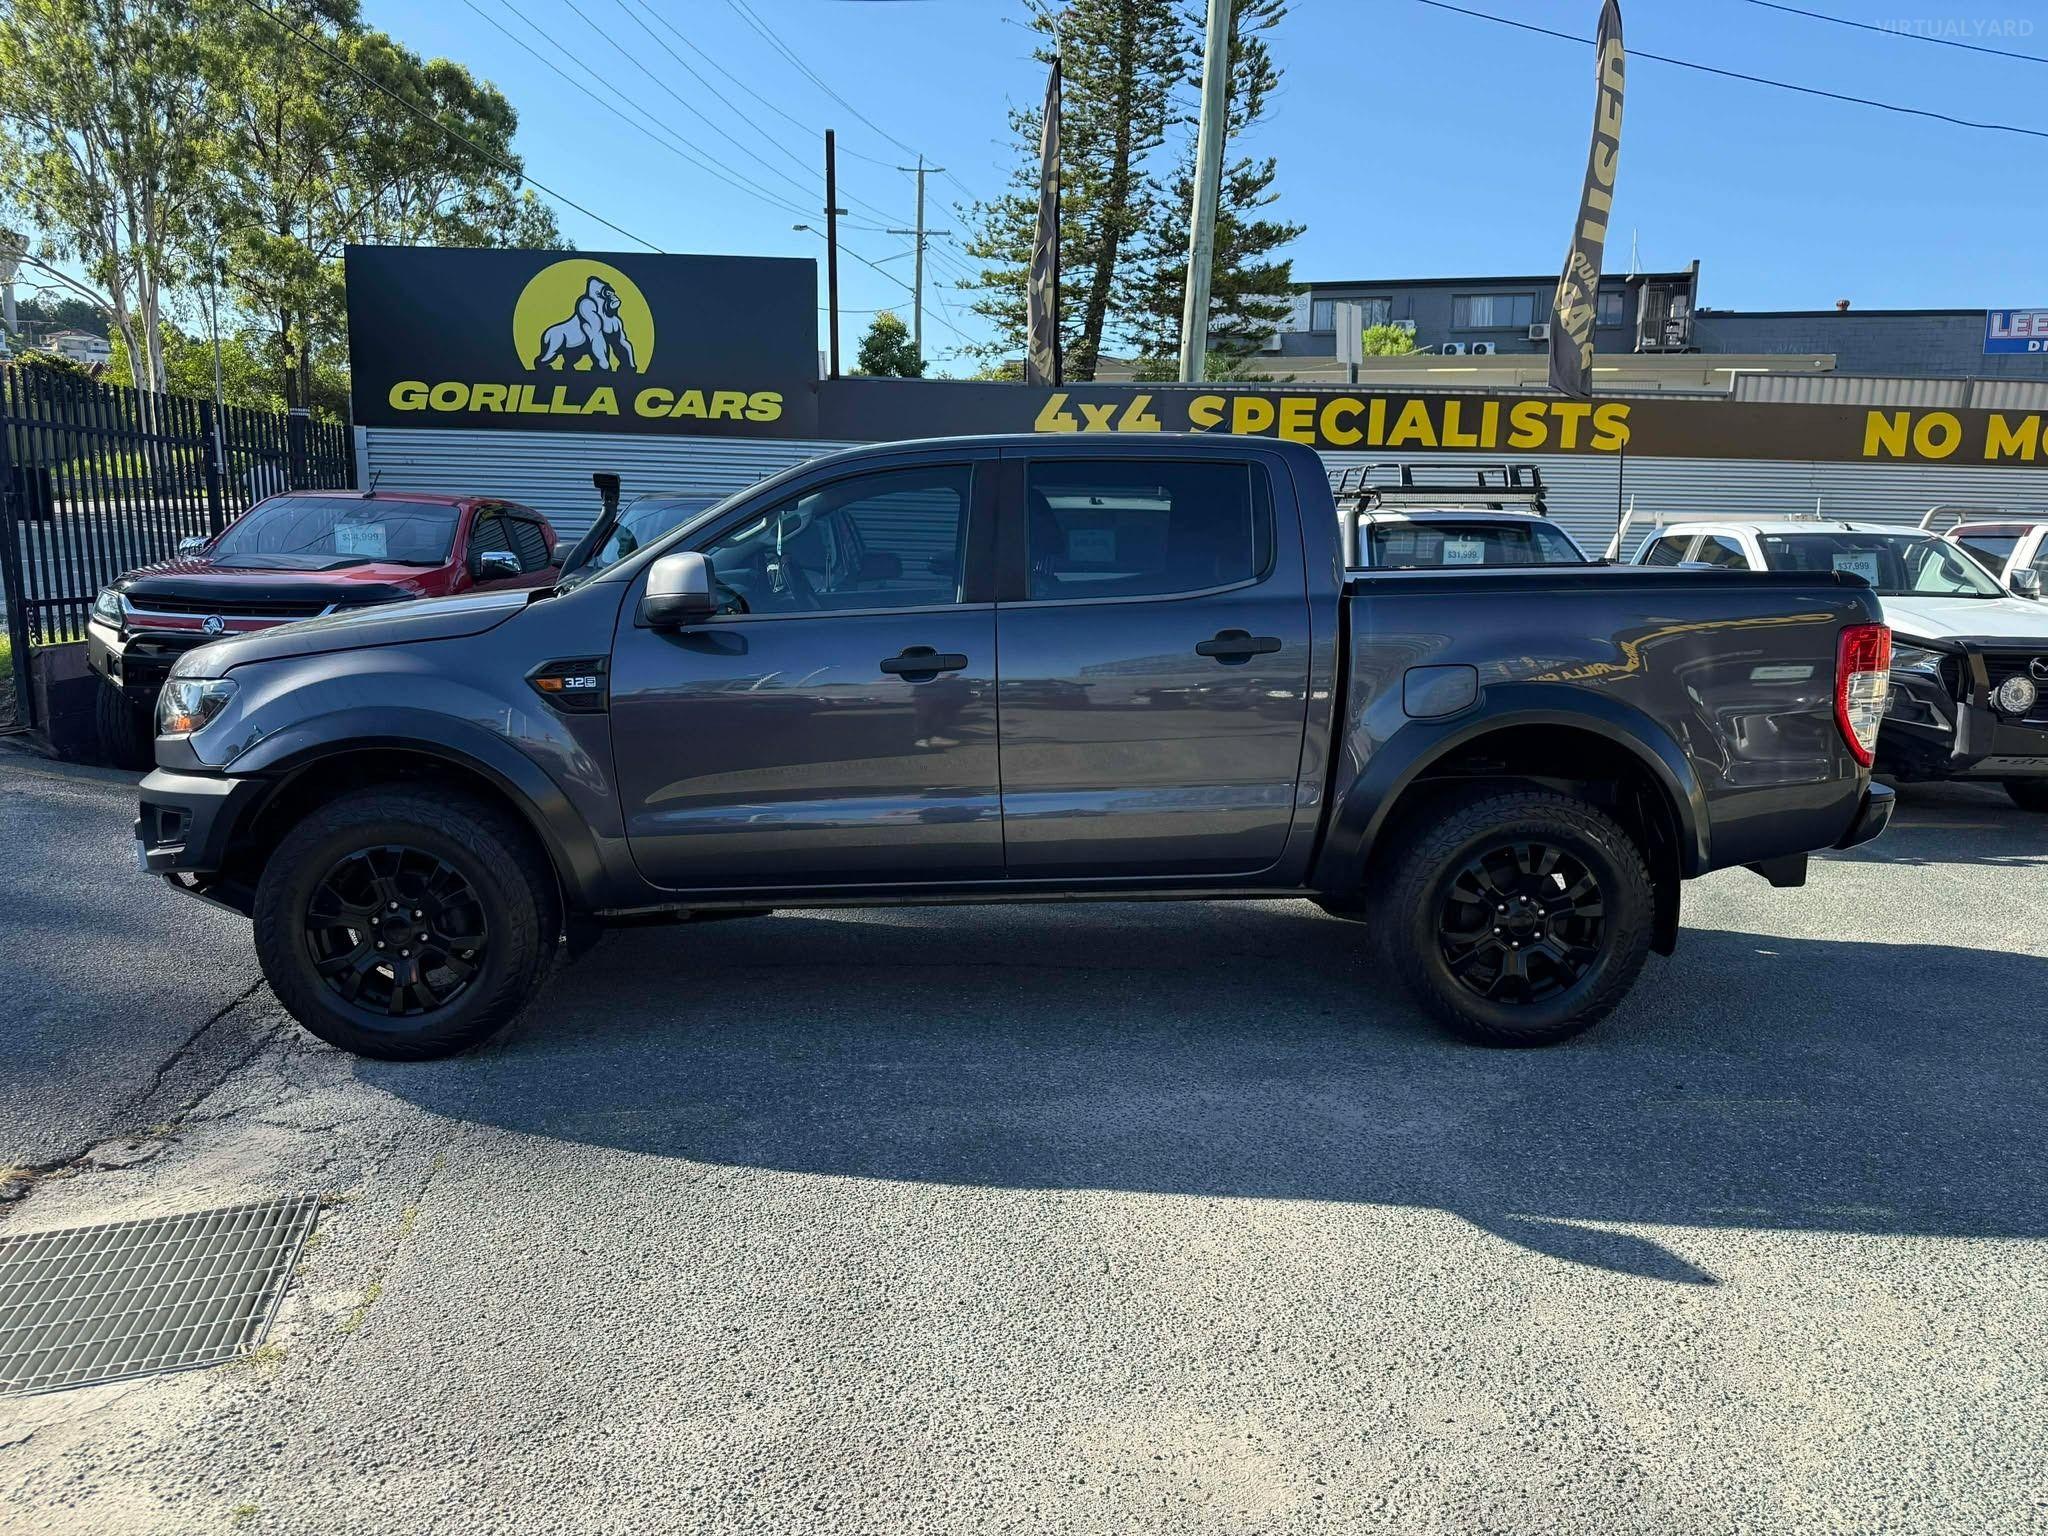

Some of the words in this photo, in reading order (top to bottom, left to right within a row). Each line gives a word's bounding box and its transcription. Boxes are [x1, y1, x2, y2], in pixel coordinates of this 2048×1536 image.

[388, 380, 620, 416] GORILLA
[634, 387, 784, 422] CARS
[1034, 393, 1162, 433] 4x4
[1187, 395, 1632, 451] SPECIALISTS
[1862, 410, 1962, 459] NO
[1984, 414, 2048, 461] M
